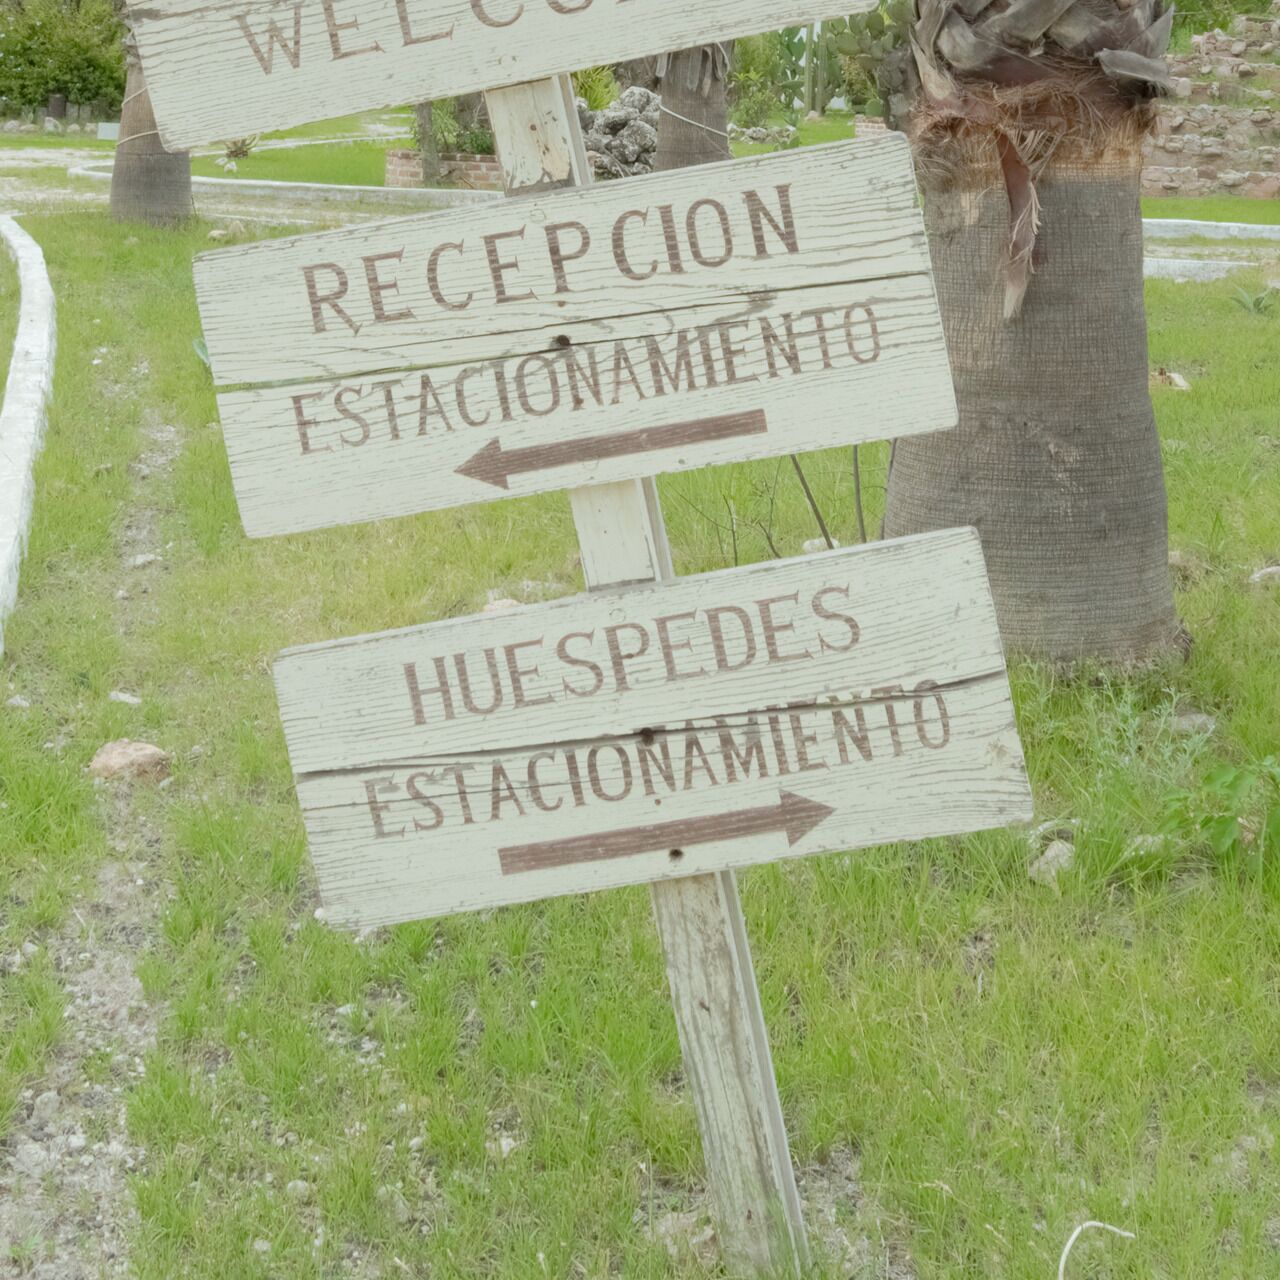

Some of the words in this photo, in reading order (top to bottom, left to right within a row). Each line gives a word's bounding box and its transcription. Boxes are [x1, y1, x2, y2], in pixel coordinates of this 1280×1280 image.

[301, 184, 801, 336] RECEPCION
[290, 301, 882, 455] ESTACIONAMIENTO
[403, 585, 862, 725] HUESPEDES
[363, 678, 953, 839] ESTACIONAMIENTO
